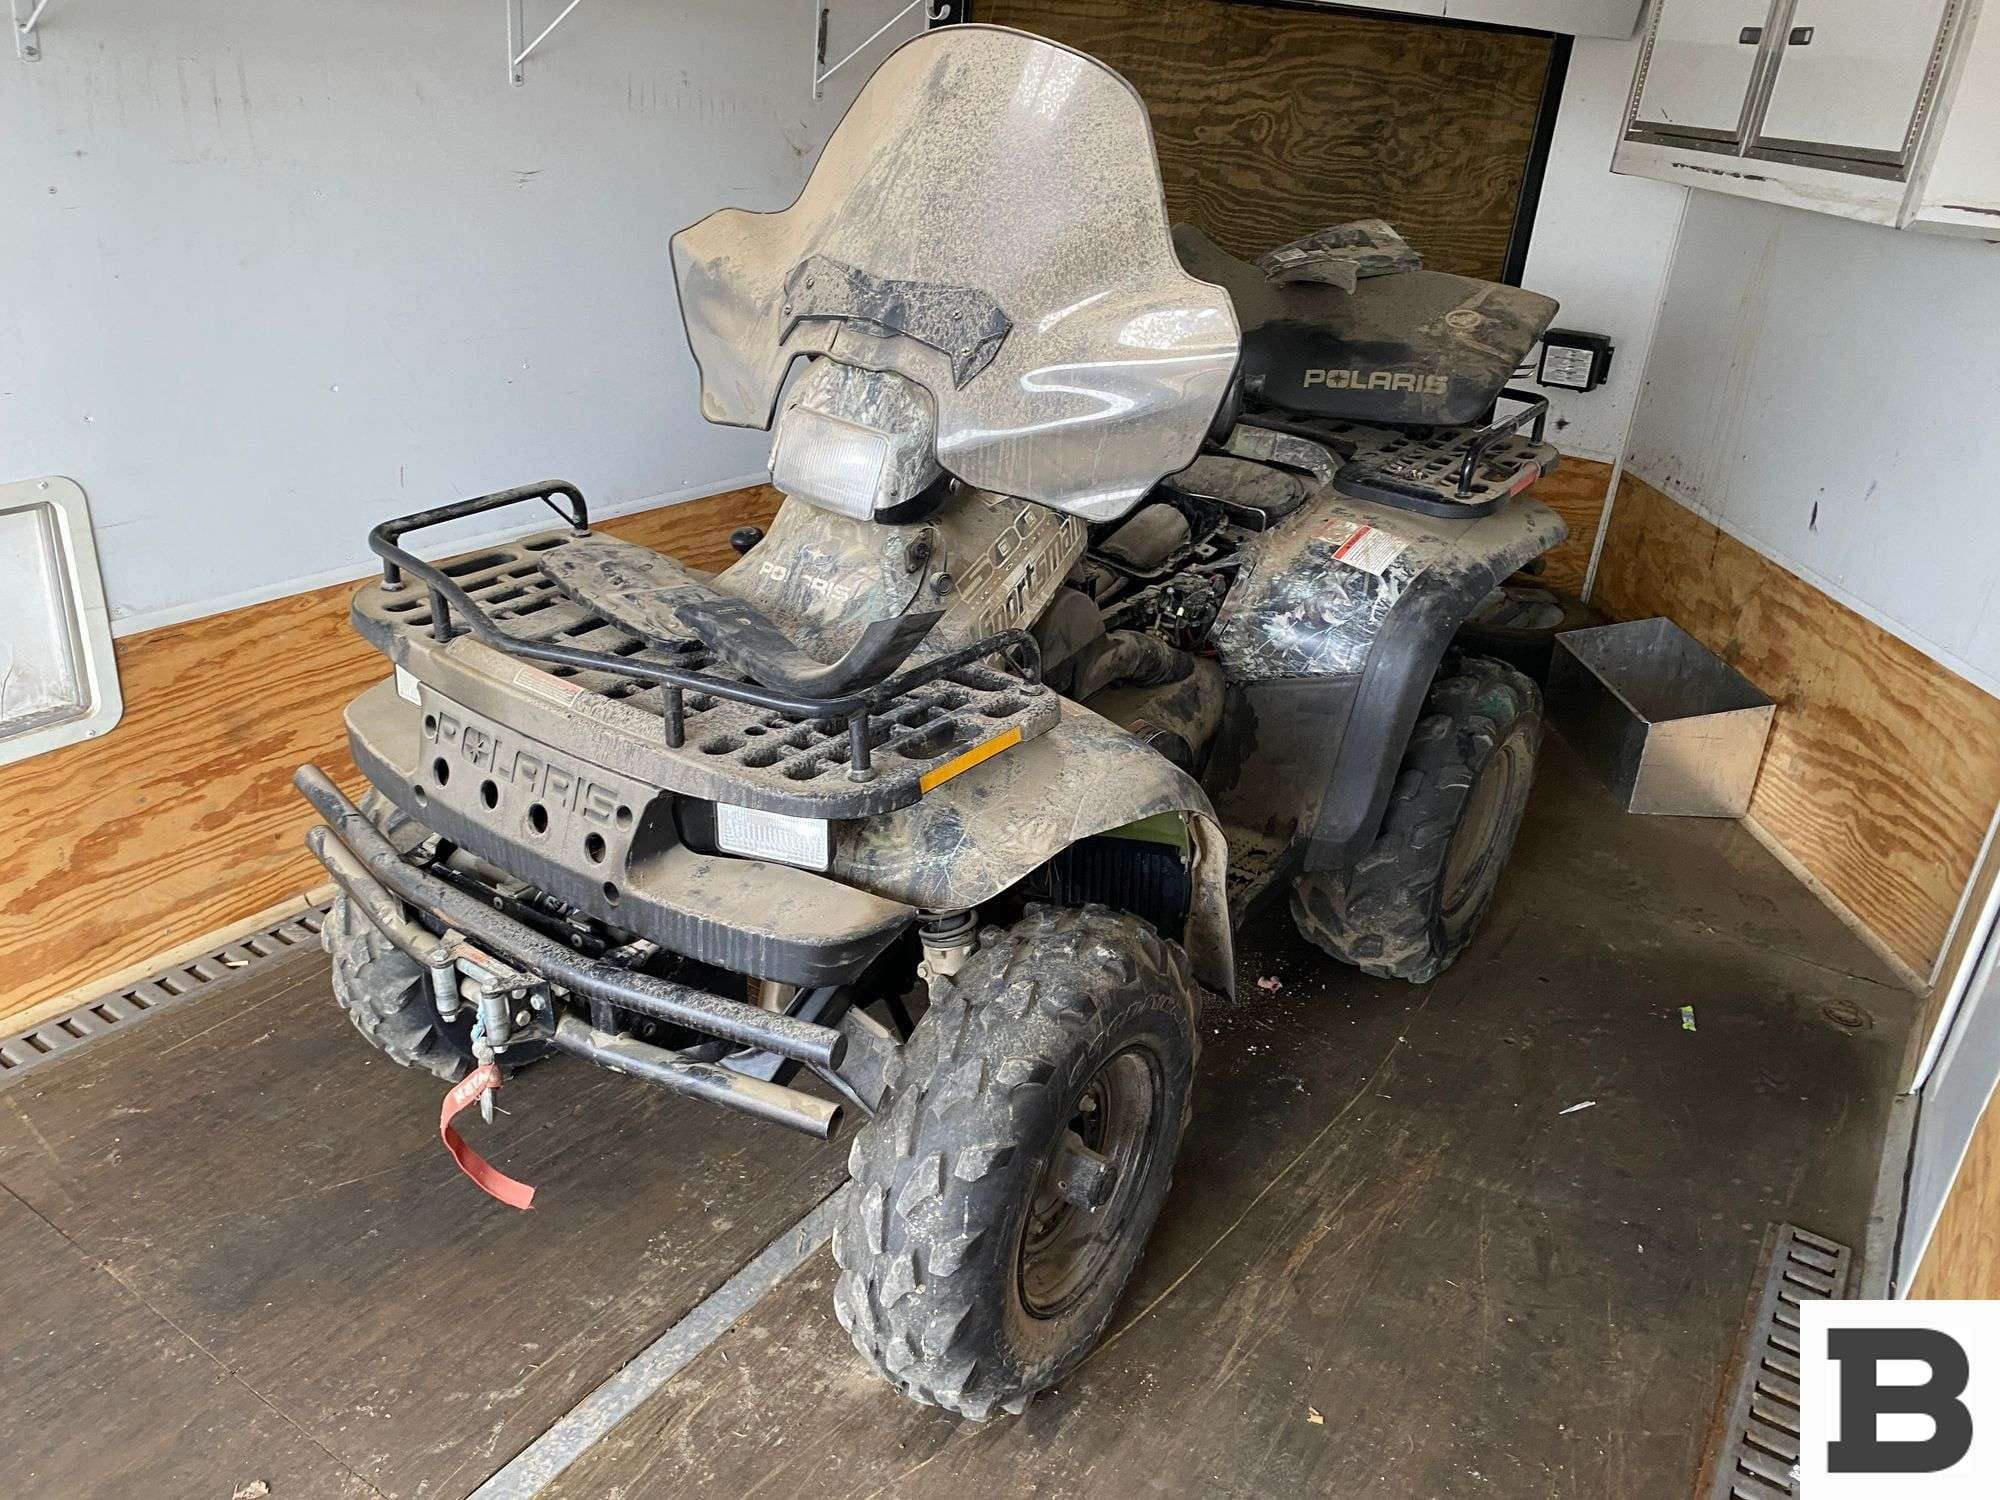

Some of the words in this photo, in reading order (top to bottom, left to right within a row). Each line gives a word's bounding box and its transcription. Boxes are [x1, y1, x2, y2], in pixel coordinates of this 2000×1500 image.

[1303, 368, 1449, 396] POLARIS
[955, 503, 1046, 603] 500
[435, 711, 618, 824] POLARIS
